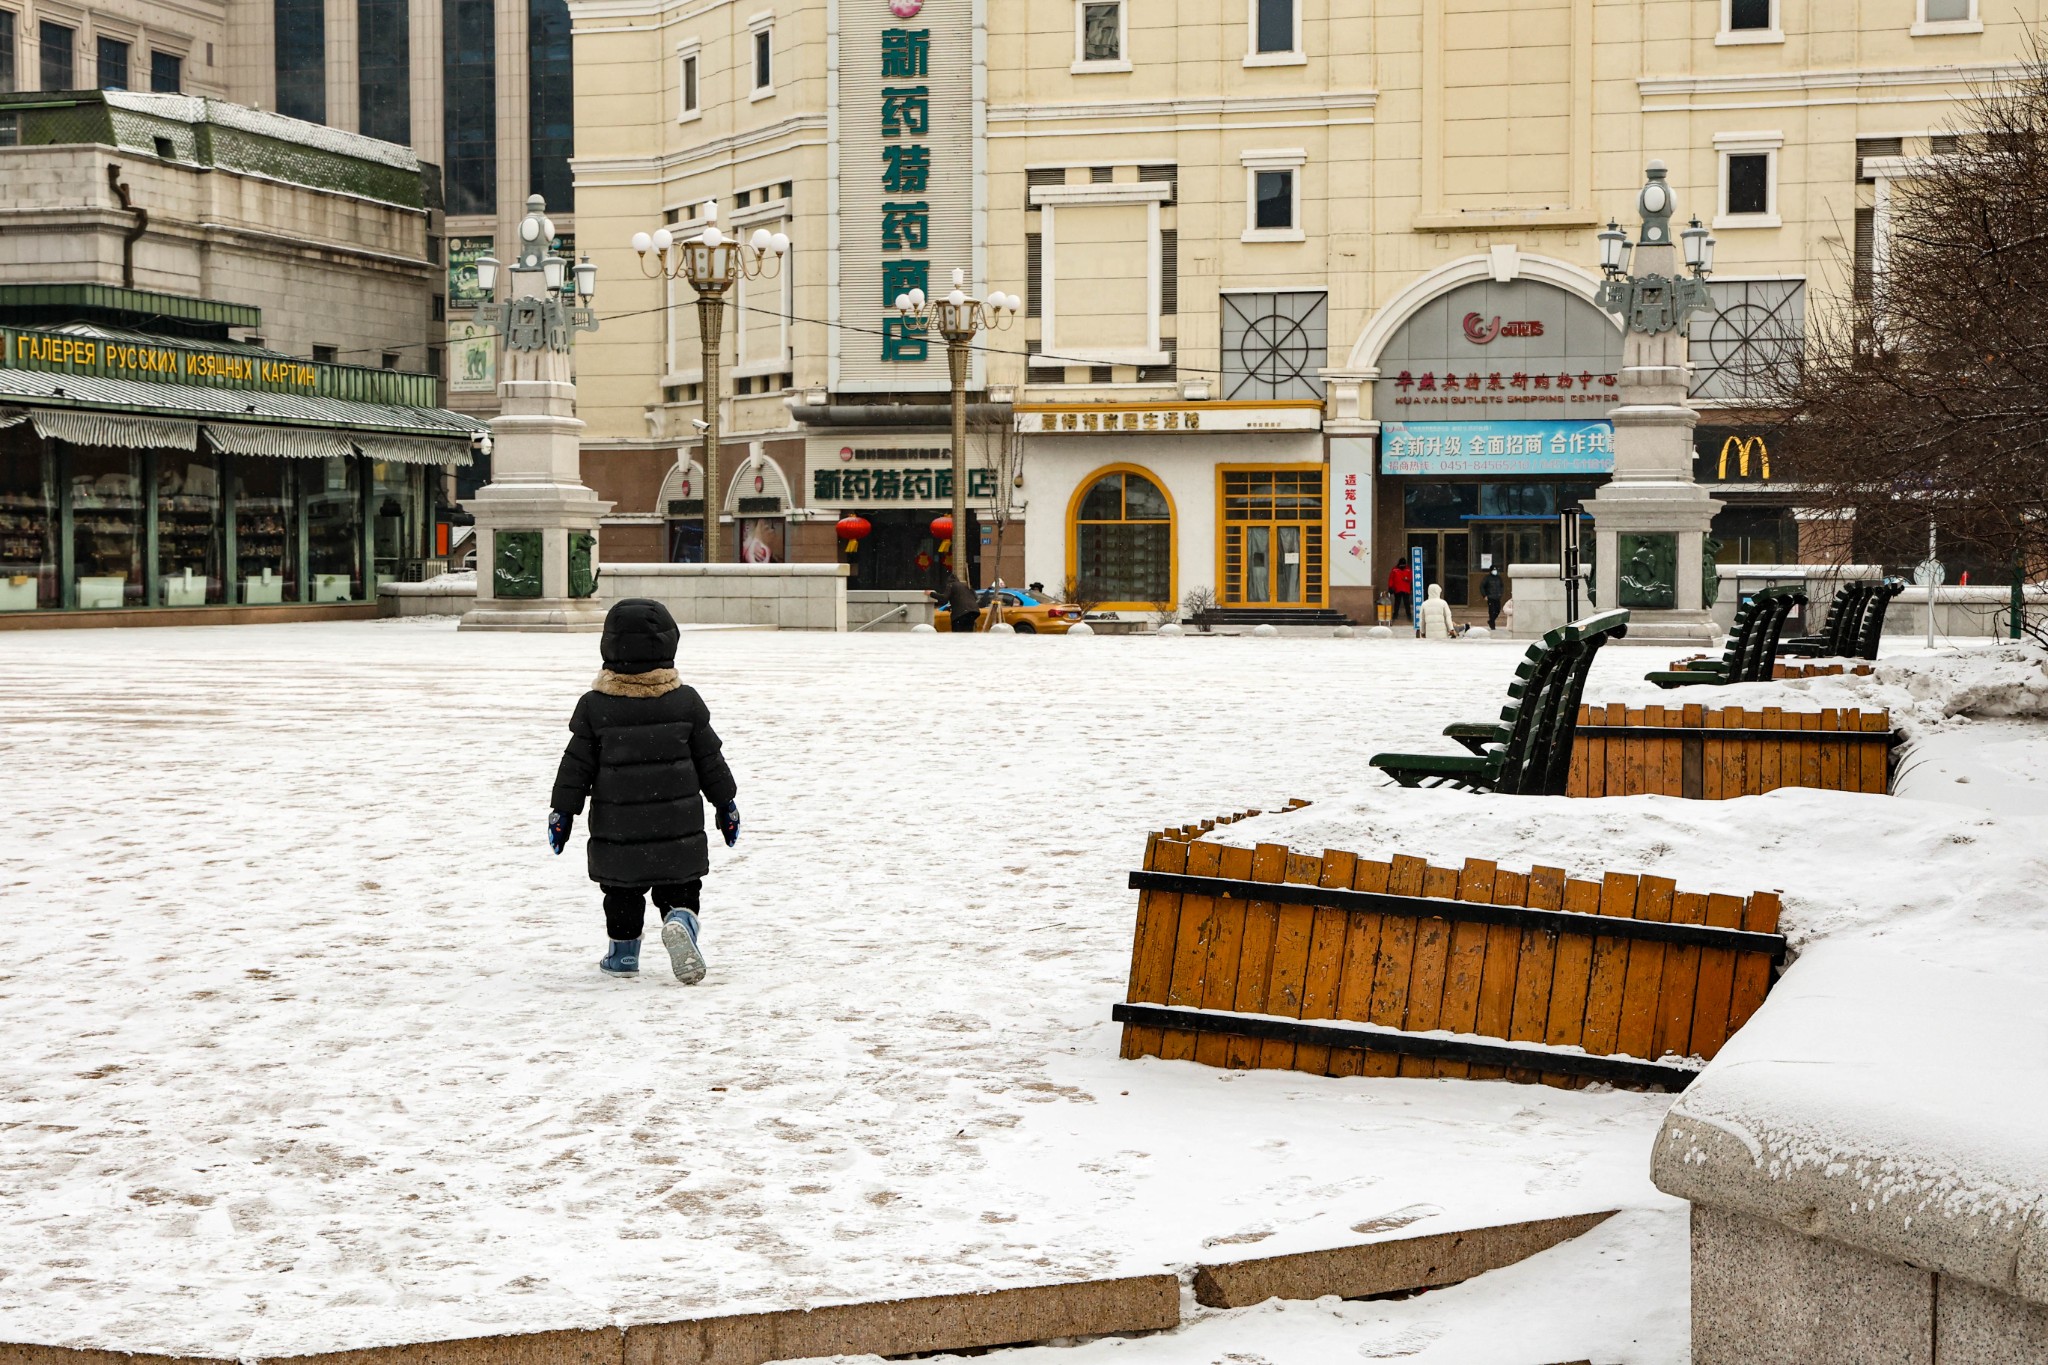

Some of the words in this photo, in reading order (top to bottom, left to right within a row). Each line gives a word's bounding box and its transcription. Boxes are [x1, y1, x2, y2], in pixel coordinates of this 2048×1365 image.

[881, 28, 930, 361] 新药特药商店
[17, 336, 96, 365] ГАЛЕРЕЯ
[106, 345, 178, 374] РУССКИХ
[187, 354, 252, 380] ИЗЯЩНЫХ
[261, 362, 316, 387] КАРТИН
[1395, 396, 1448, 405] HUAYAN
[1451, 395, 1503, 404] OUTLETS
[1507, 395, 1565, 404] SHOPPING
[1570, 394, 1619, 403] CENTER
[1389, 435, 1462, 457] 全新升级
[1469, 434, 1543, 455] 全面招商
